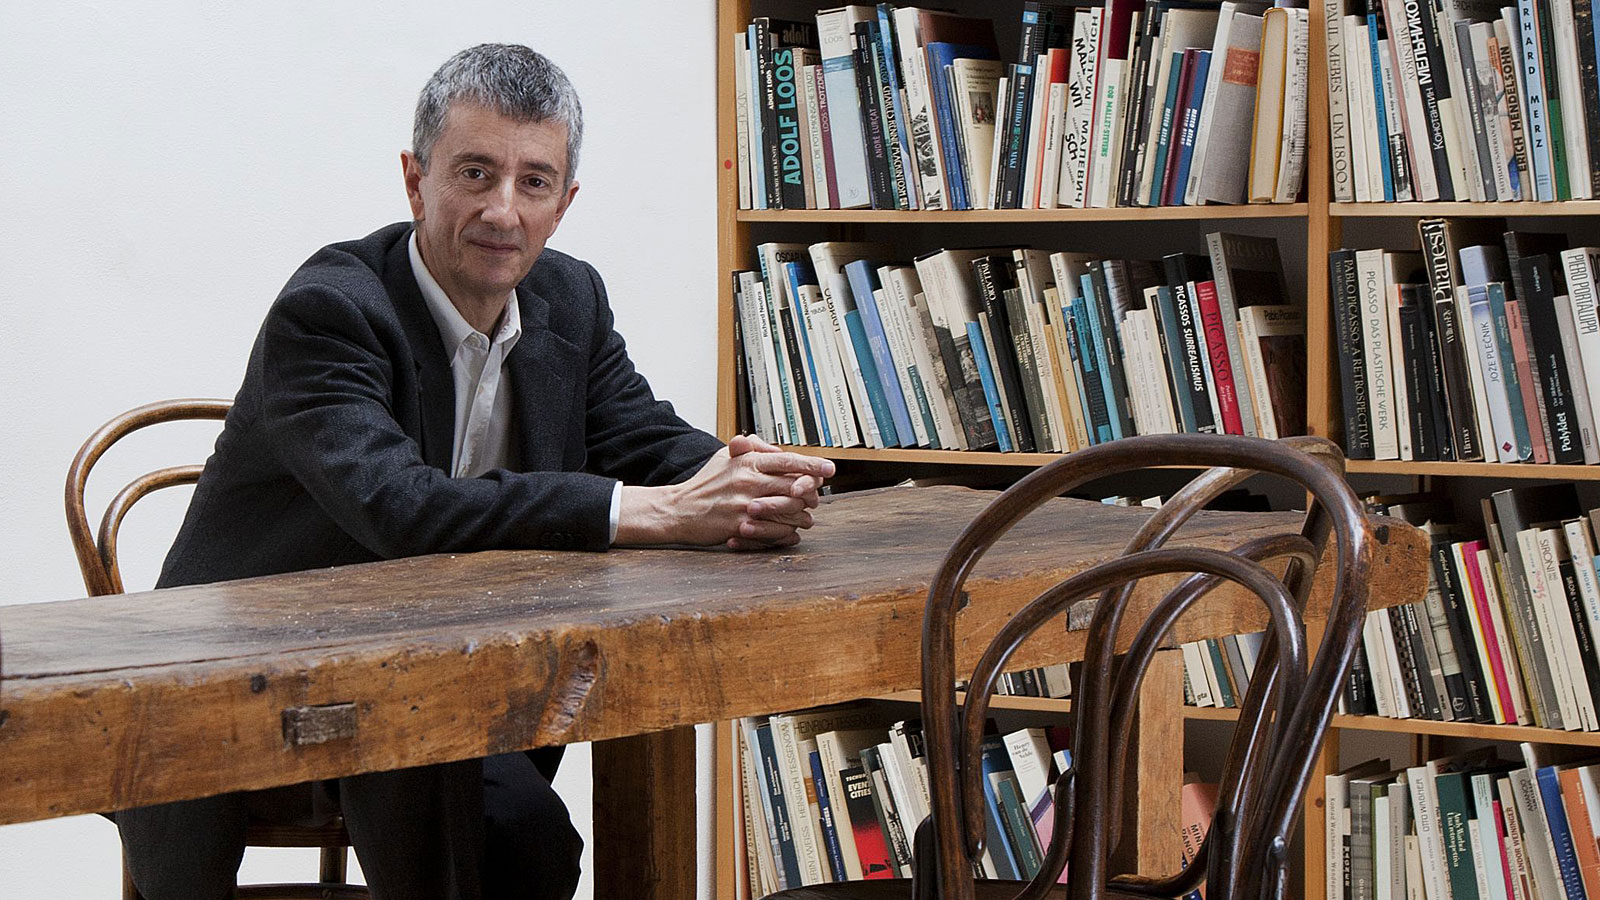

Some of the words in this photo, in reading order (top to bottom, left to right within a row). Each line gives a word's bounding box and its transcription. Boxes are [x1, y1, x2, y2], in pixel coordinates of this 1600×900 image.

[1326, 2, 1338, 36] PAUL
[824, 36, 844, 44] LOOS
[1400, 26, 1416, 81] MELNIKOV
[1404, 0, 1432, 85] МЕЛЬНИКО
[1084, 16, 1098, 100] MALEVICH
[1329, 44, 1342, 92] MEBES
[1522, 0, 1536, 75] RHARD
[1530, 95, 1543, 148] MERZ
[774, 50, 796, 109] LOOS
[806, 70, 814, 92] STADT
[816, 68, 827, 109] TROTZDEM
[1500, 46, 1520, 130] MENDELSOHN
[767, 89, 775, 110] ADOLF
[882, 86, 894, 119] CHARLES
[869, 108, 878, 134] LURÇAT
[886, 120, 898, 146] RENNIE
[1333, 114, 1344, 138] UM
[1425, 88, 1444, 150] Константин
[780, 116, 801, 184] ADOLF
[873, 136, 883, 158] ANDRÉ
[1075, 120, 1088, 202] МАЛЕВИЧ
[1516, 137, 1526, 172] ERICH
[892, 147, 906, 196] MACKINTOSH
[1212, 240, 1222, 272] PICASSO
[1425, 230, 1454, 305] Piranesi
[1568, 254, 1588, 280] PIERO
[982, 263, 996, 300] PALLADIO
[1344, 260, 1356, 294] PABLO
[1366, 271, 1379, 314] PICASSO
[1348, 296, 1360, 344] PICASSO:
[1572, 282, 1598, 334] PORTALUPPI
[760, 314, 768, 338] Richard
[1176, 286, 1192, 326] PICASSOS
[1184, 328, 1204, 391] SURREALISMUS
[1370, 319, 1380, 340] DAS
[1480, 322, 1495, 360] PLEČNIK
[1206, 312, 1228, 381] PICASSO
[1352, 348, 1360, 356] A
[1372, 341, 1386, 398] PLASTISCHE
[1488, 361, 1499, 382] JOŽE
[1352, 358, 1369, 449] RETROSPECTIVE
[1377, 400, 1388, 430] WERK
[1556, 412, 1572, 451] Polyklet
[1439, 550, 1448, 570] Gottfried
[1540, 539, 1555, 572] SIRONI
[1443, 572, 1452, 588] Semper
[1566, 576, 1576, 596] SIRONI
[1582, 569, 1592, 593] SIRONI
[1590, 598, 1599, 620] MARIO
[794, 718, 833, 734] HEINRICH
[780, 723, 798, 774] TESSENOW
[792, 776, 806, 818] HEINRICH
[850, 789, 872, 799] CITIES
[1420, 814, 1430, 832] OTTO
[1447, 812, 1456, 826] Una
[1505, 806, 1521, 846] WEININGER
[1456, 828, 1466, 852] Warhol
[1513, 847, 1525, 872] ANDOR
[1330, 862, 1338, 900] Wendepunk
